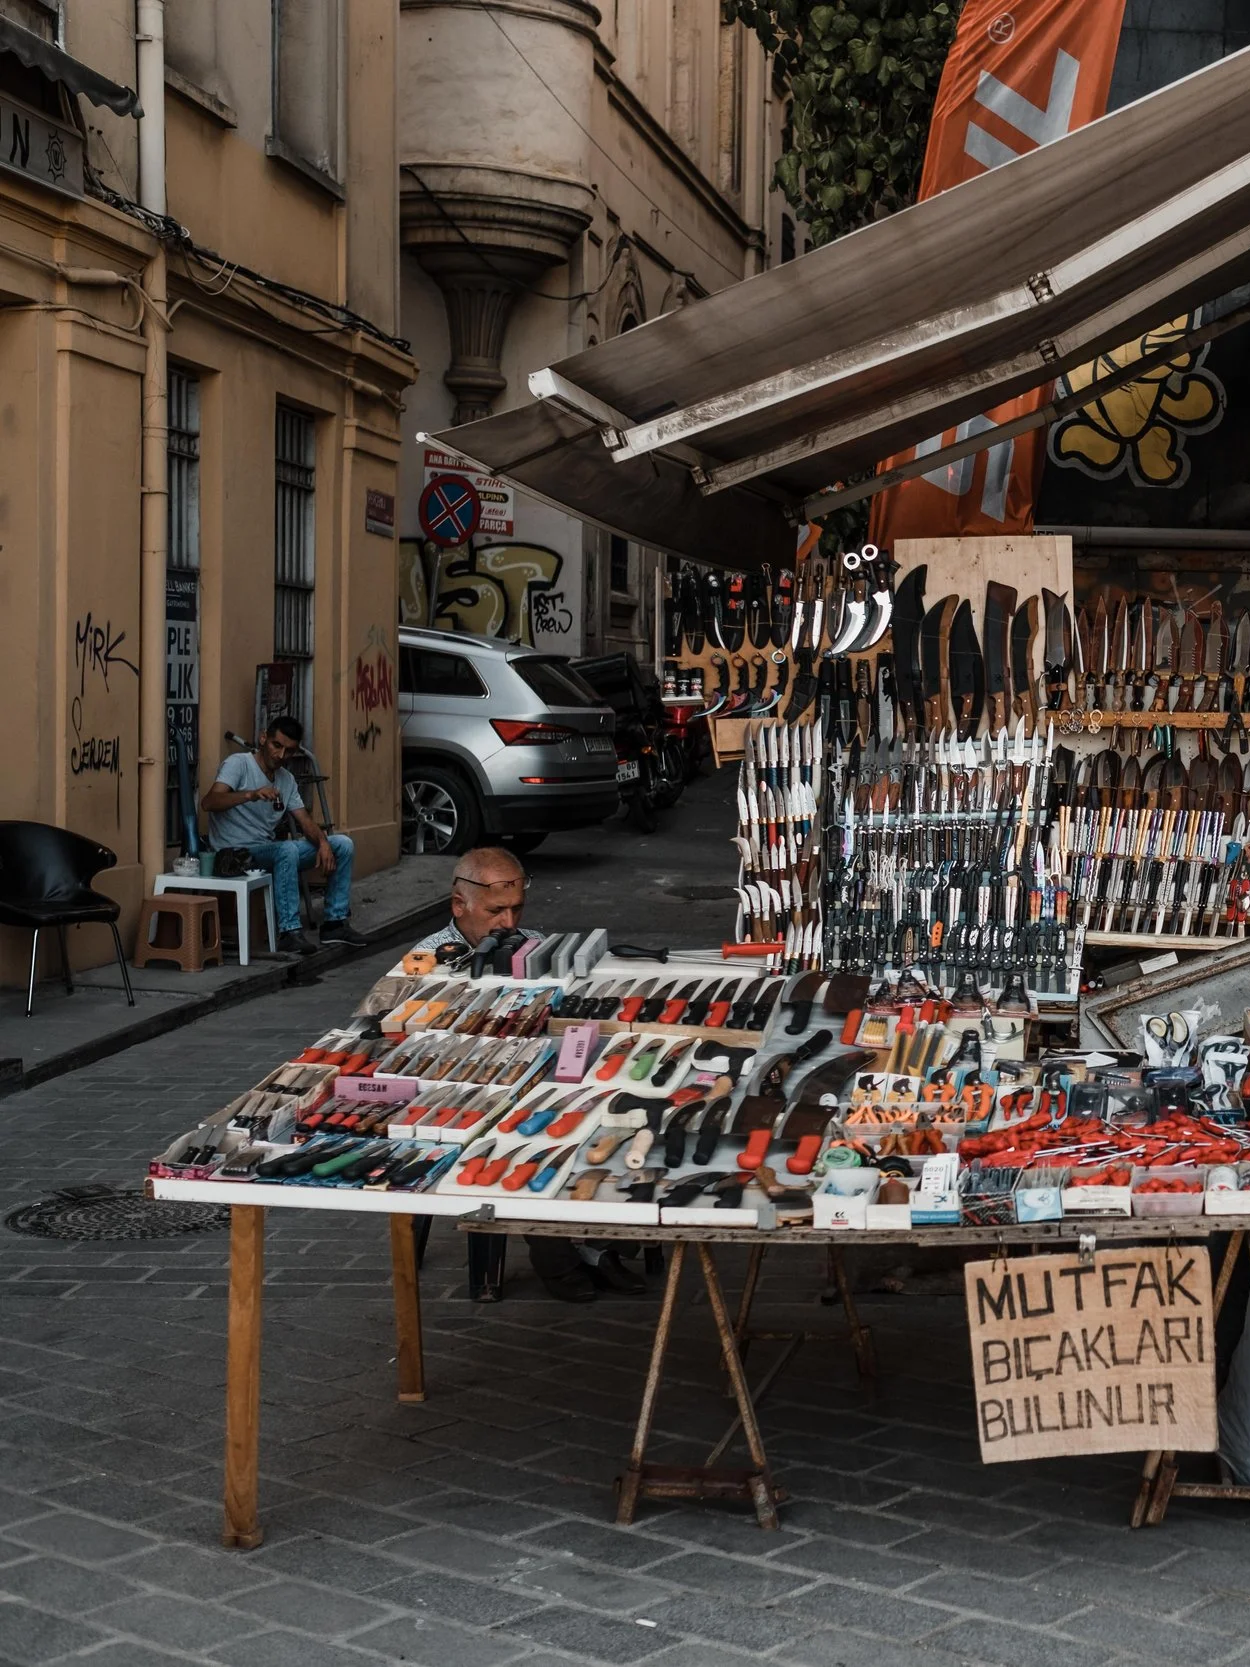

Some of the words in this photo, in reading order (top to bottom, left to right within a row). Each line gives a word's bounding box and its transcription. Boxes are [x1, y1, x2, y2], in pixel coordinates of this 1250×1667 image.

[479, 519, 507, 533] PARÇA
[167, 627, 191, 656] PLE
[166, 663, 194, 700] LIK
[975, 1258, 1201, 1325] MUTFAK
[982, 1317, 1204, 1385] BIÇAKLARI
[980, 1383, 1177, 1443] BULUNUR
